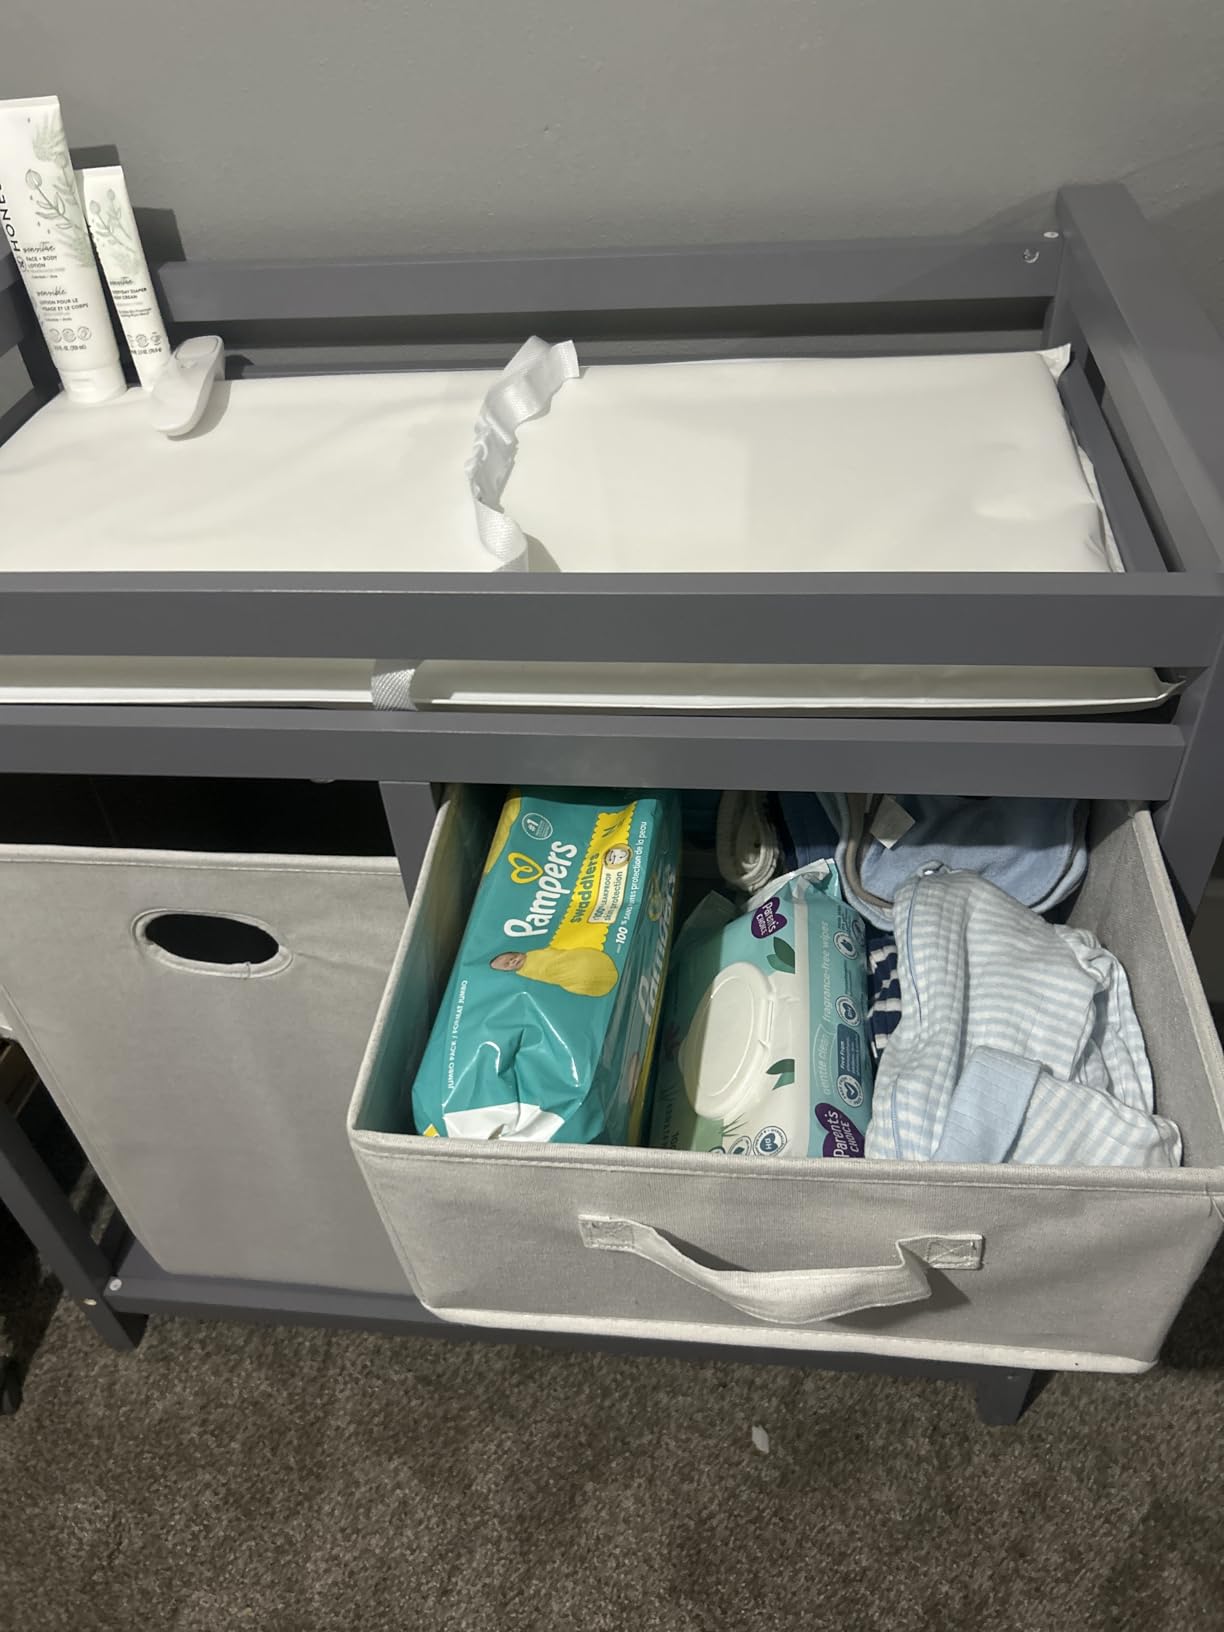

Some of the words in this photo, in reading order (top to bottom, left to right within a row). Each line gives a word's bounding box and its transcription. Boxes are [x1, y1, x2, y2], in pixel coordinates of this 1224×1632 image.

[635, 838, 645, 846] la
[639, 820, 648, 839] peau
[633, 846, 643, 855] de
[630, 855, 642, 890] protection
[503, 840, 578, 937] Pampers
[570, 852, 600, 924] swaddlers
[600, 872, 612, 905] LEAKPROOF
[610, 871, 624, 909] protection
[821, 920, 830, 948] wipes
[459, 979, 469, 1004] JUMBO
[452, 1005, 464, 1034] FORMAT
[449, 1040, 457, 1061] PACK
[447, 1061, 455, 1090] JUMBO
[824, 1109, 850, 1158] Parent's
[839, 1119, 860, 1153] CHOICE
